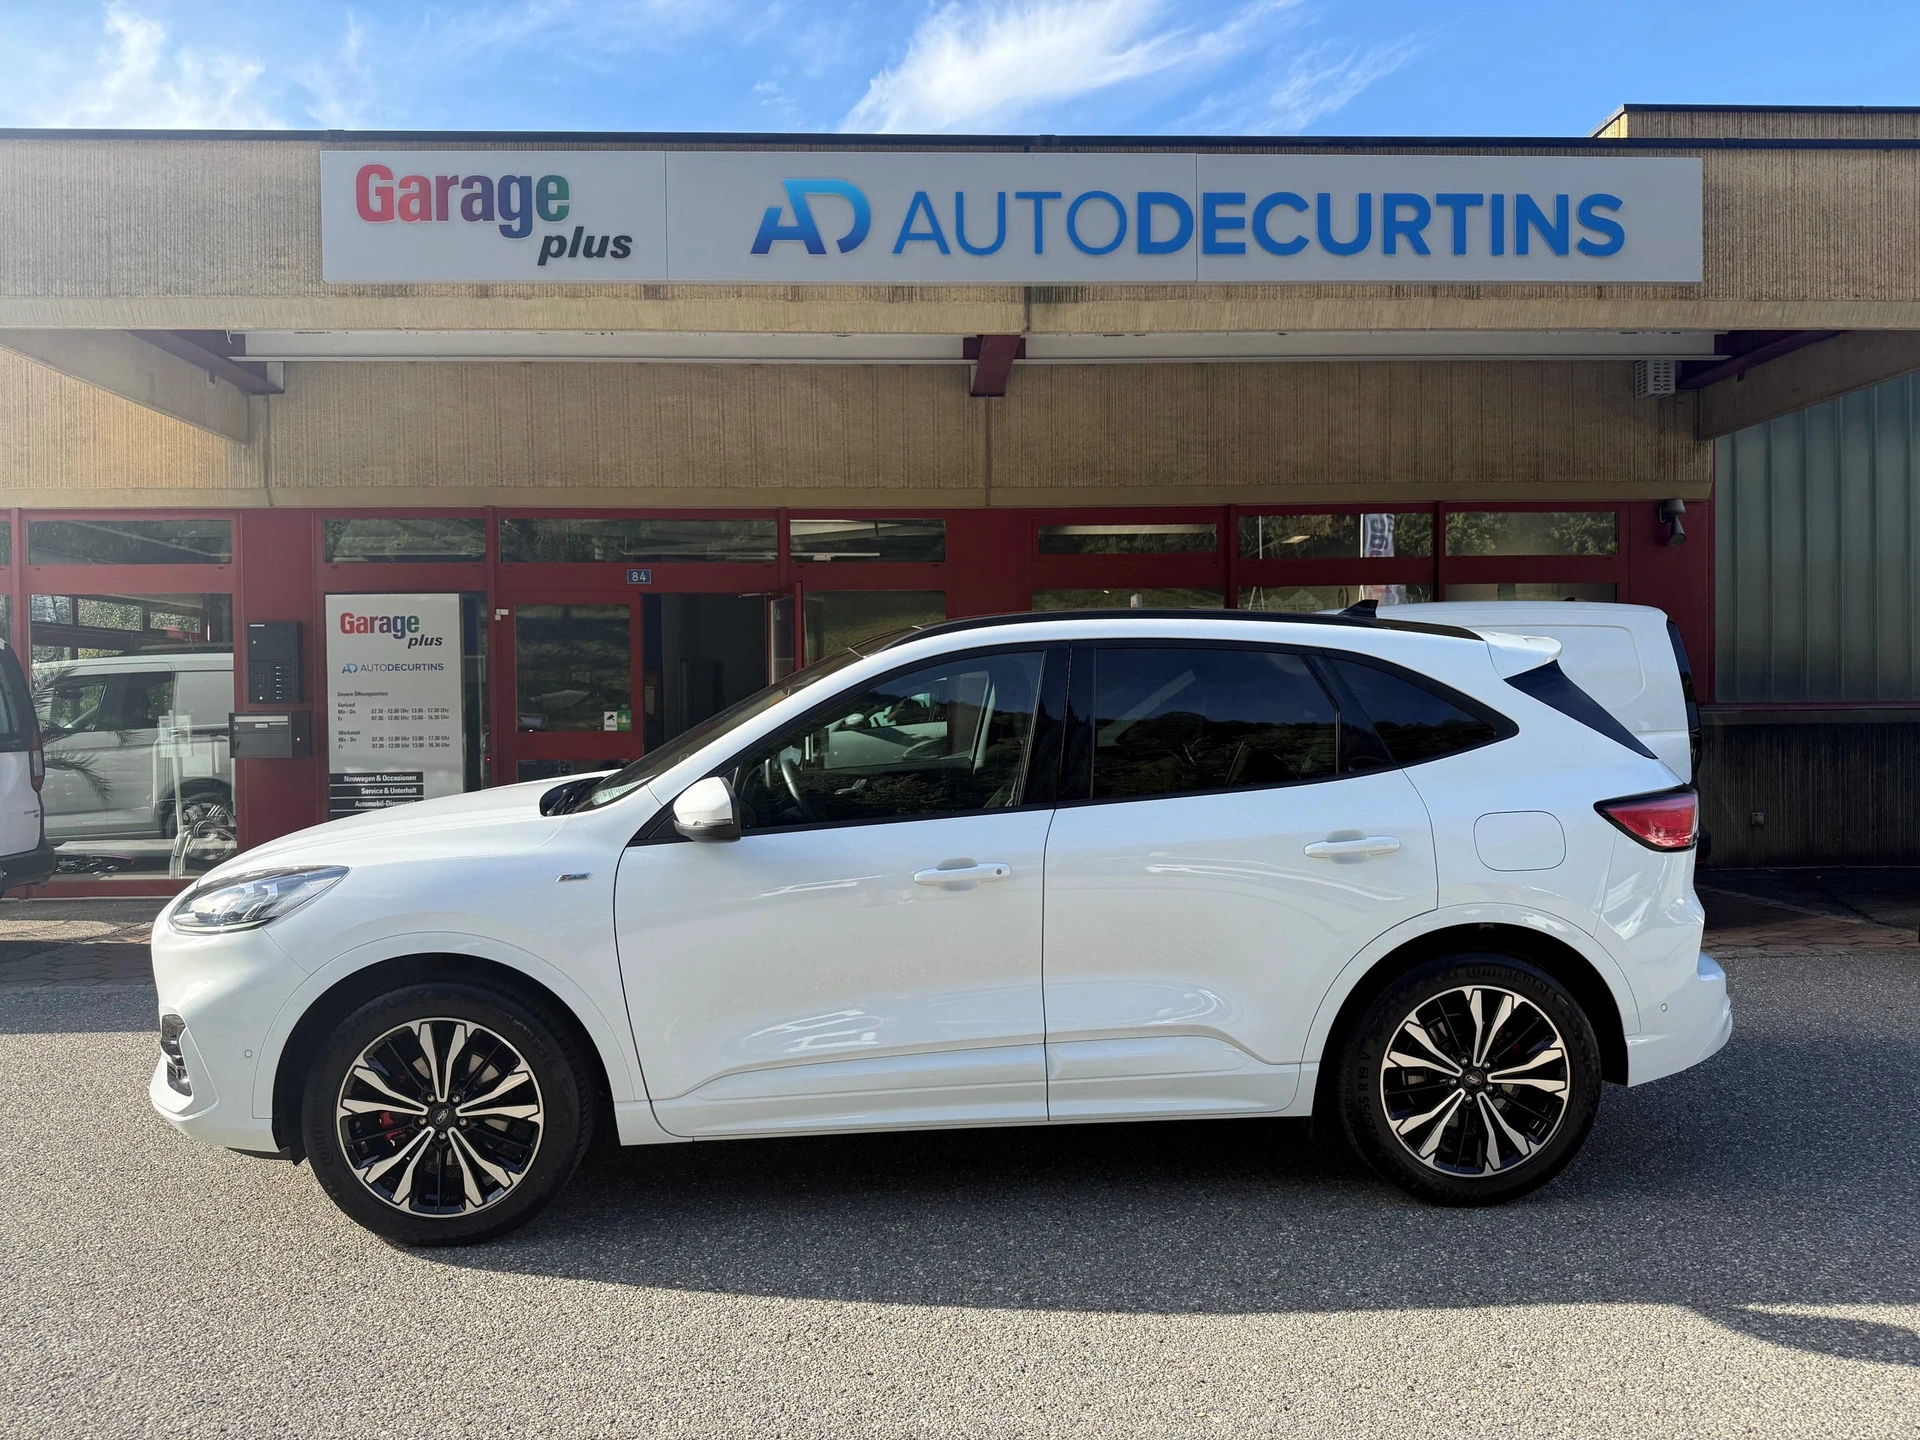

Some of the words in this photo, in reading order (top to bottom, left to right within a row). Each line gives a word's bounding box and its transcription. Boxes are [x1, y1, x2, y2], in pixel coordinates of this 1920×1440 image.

[355, 163, 571, 240] Garage
[892, 189, 1627, 257] AUTODECURTINS
[537, 226, 633, 266] plus
[631, 571, 647, 583] 84
[340, 612, 420, 640] Garage
[407, 634, 444, 649] plus
[360, 662, 445, 673] AUTODECURTINS
[343, 775, 376, 783] Neuwagen
[375, 774, 382, 782] &
[361, 787, 383, 795] Service
[390, 786, 417, 794] Unterhalt
